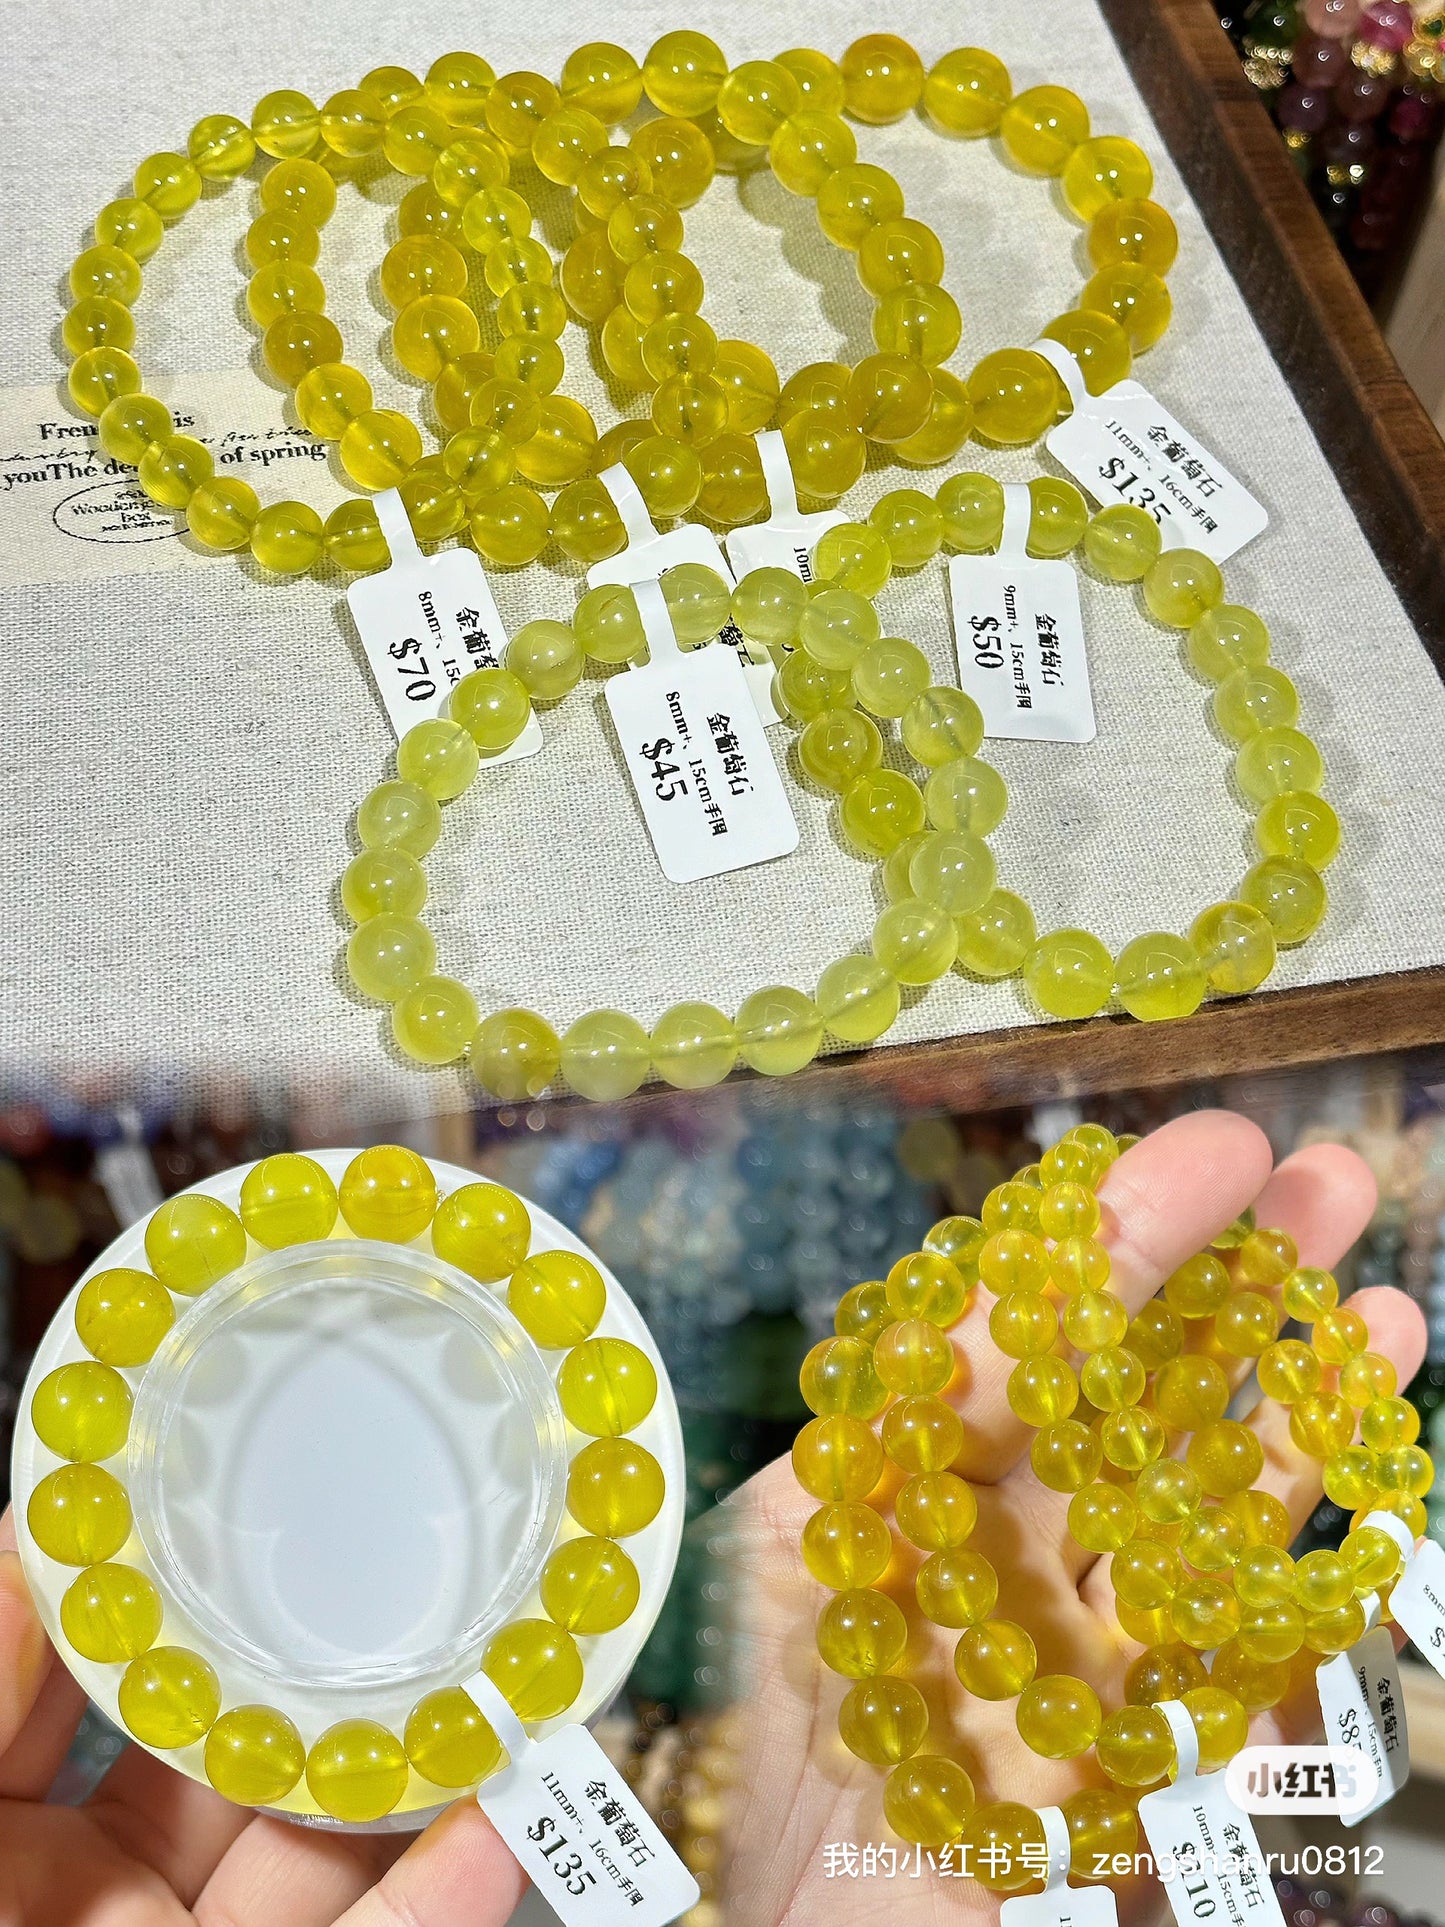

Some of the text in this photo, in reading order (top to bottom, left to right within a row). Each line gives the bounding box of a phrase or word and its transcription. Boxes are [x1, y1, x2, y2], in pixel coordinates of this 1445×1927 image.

[220, 446, 244, 464] of
[250, 441, 327, 466] spring
[1147, 424, 1223, 498] 金葡萄石
[387, 637, 436, 701] $70
[967, 615, 1004, 669] $50
[1035, 613, 1064, 686] 金葡萄石
[639, 737, 688, 801] $45
[706, 712, 754, 796] 金葡萄石
[1377, 1677, 1399, 1752] 金葡萄石
[526, 1815, 597, 1896] $135
[584, 1779, 656, 1867] 金葡萄石
